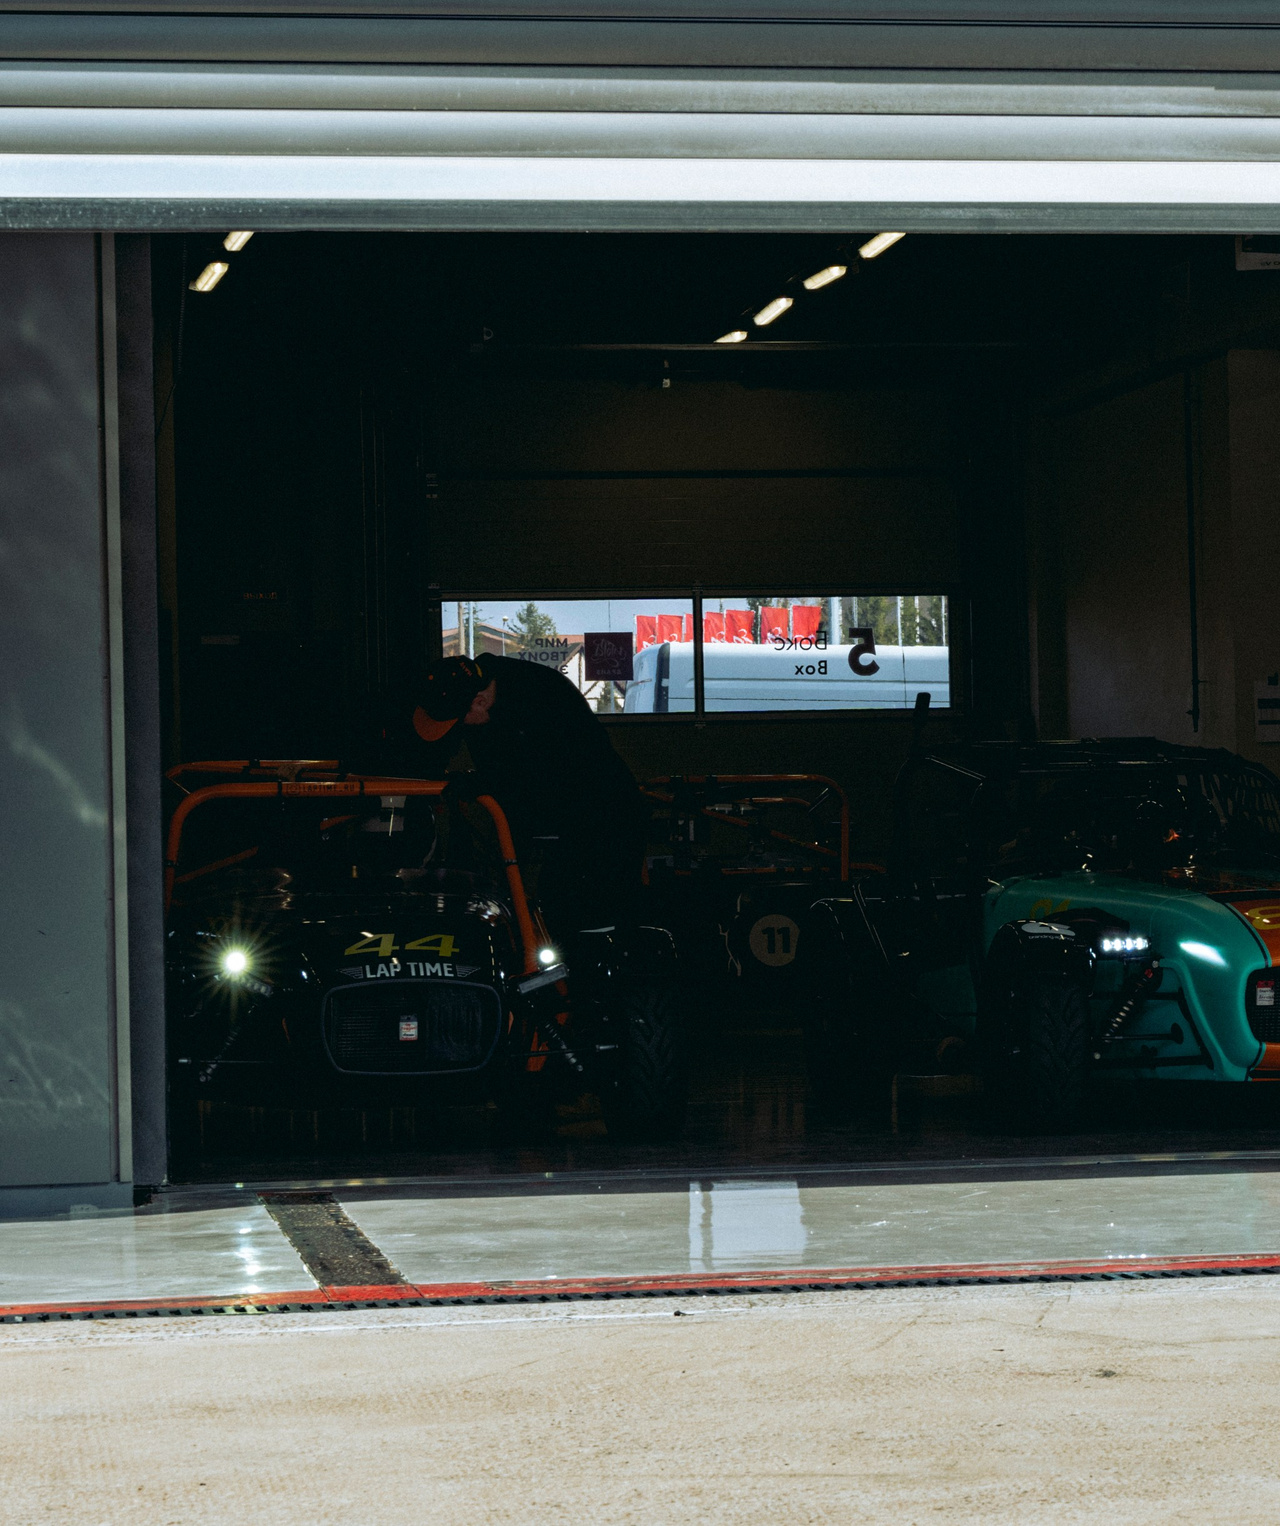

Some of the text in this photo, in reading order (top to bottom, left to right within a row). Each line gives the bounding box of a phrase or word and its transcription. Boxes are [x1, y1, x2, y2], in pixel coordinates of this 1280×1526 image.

[344, 933, 460, 957] 44
[762, 926, 791, 954] 11
[365, 962, 455, 978] LAP TIME
